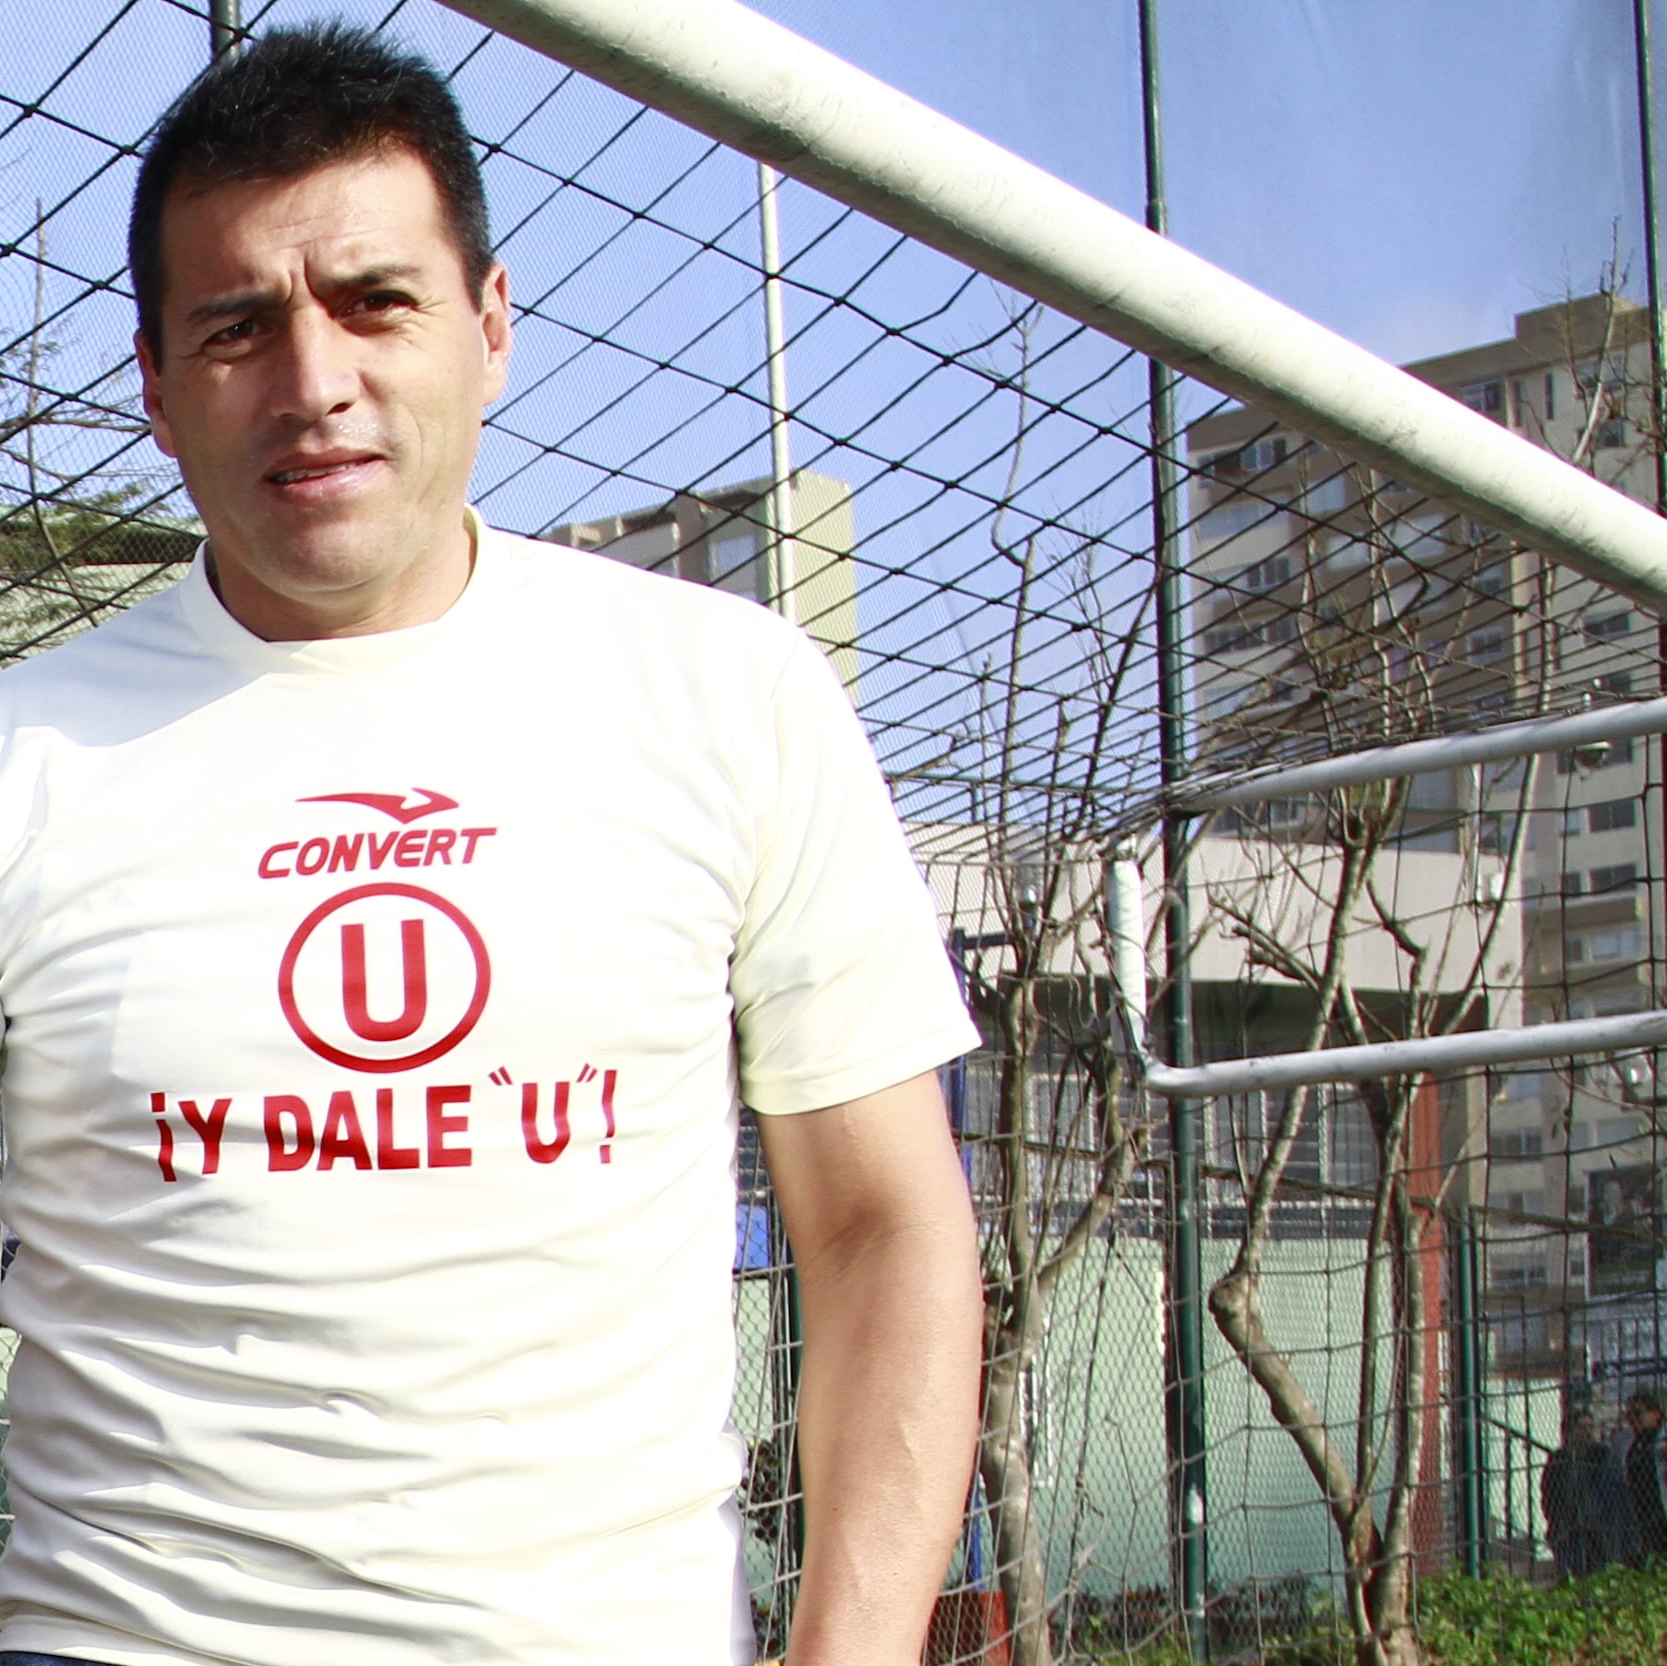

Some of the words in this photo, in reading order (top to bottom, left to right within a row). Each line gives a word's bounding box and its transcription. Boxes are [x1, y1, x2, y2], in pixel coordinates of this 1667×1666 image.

[257, 827, 497, 879] CONVERT
[340, 919, 427, 1042] U
[149, 1091, 233, 1183] ¡Y
[263, 1085, 472, 1172] DALE
